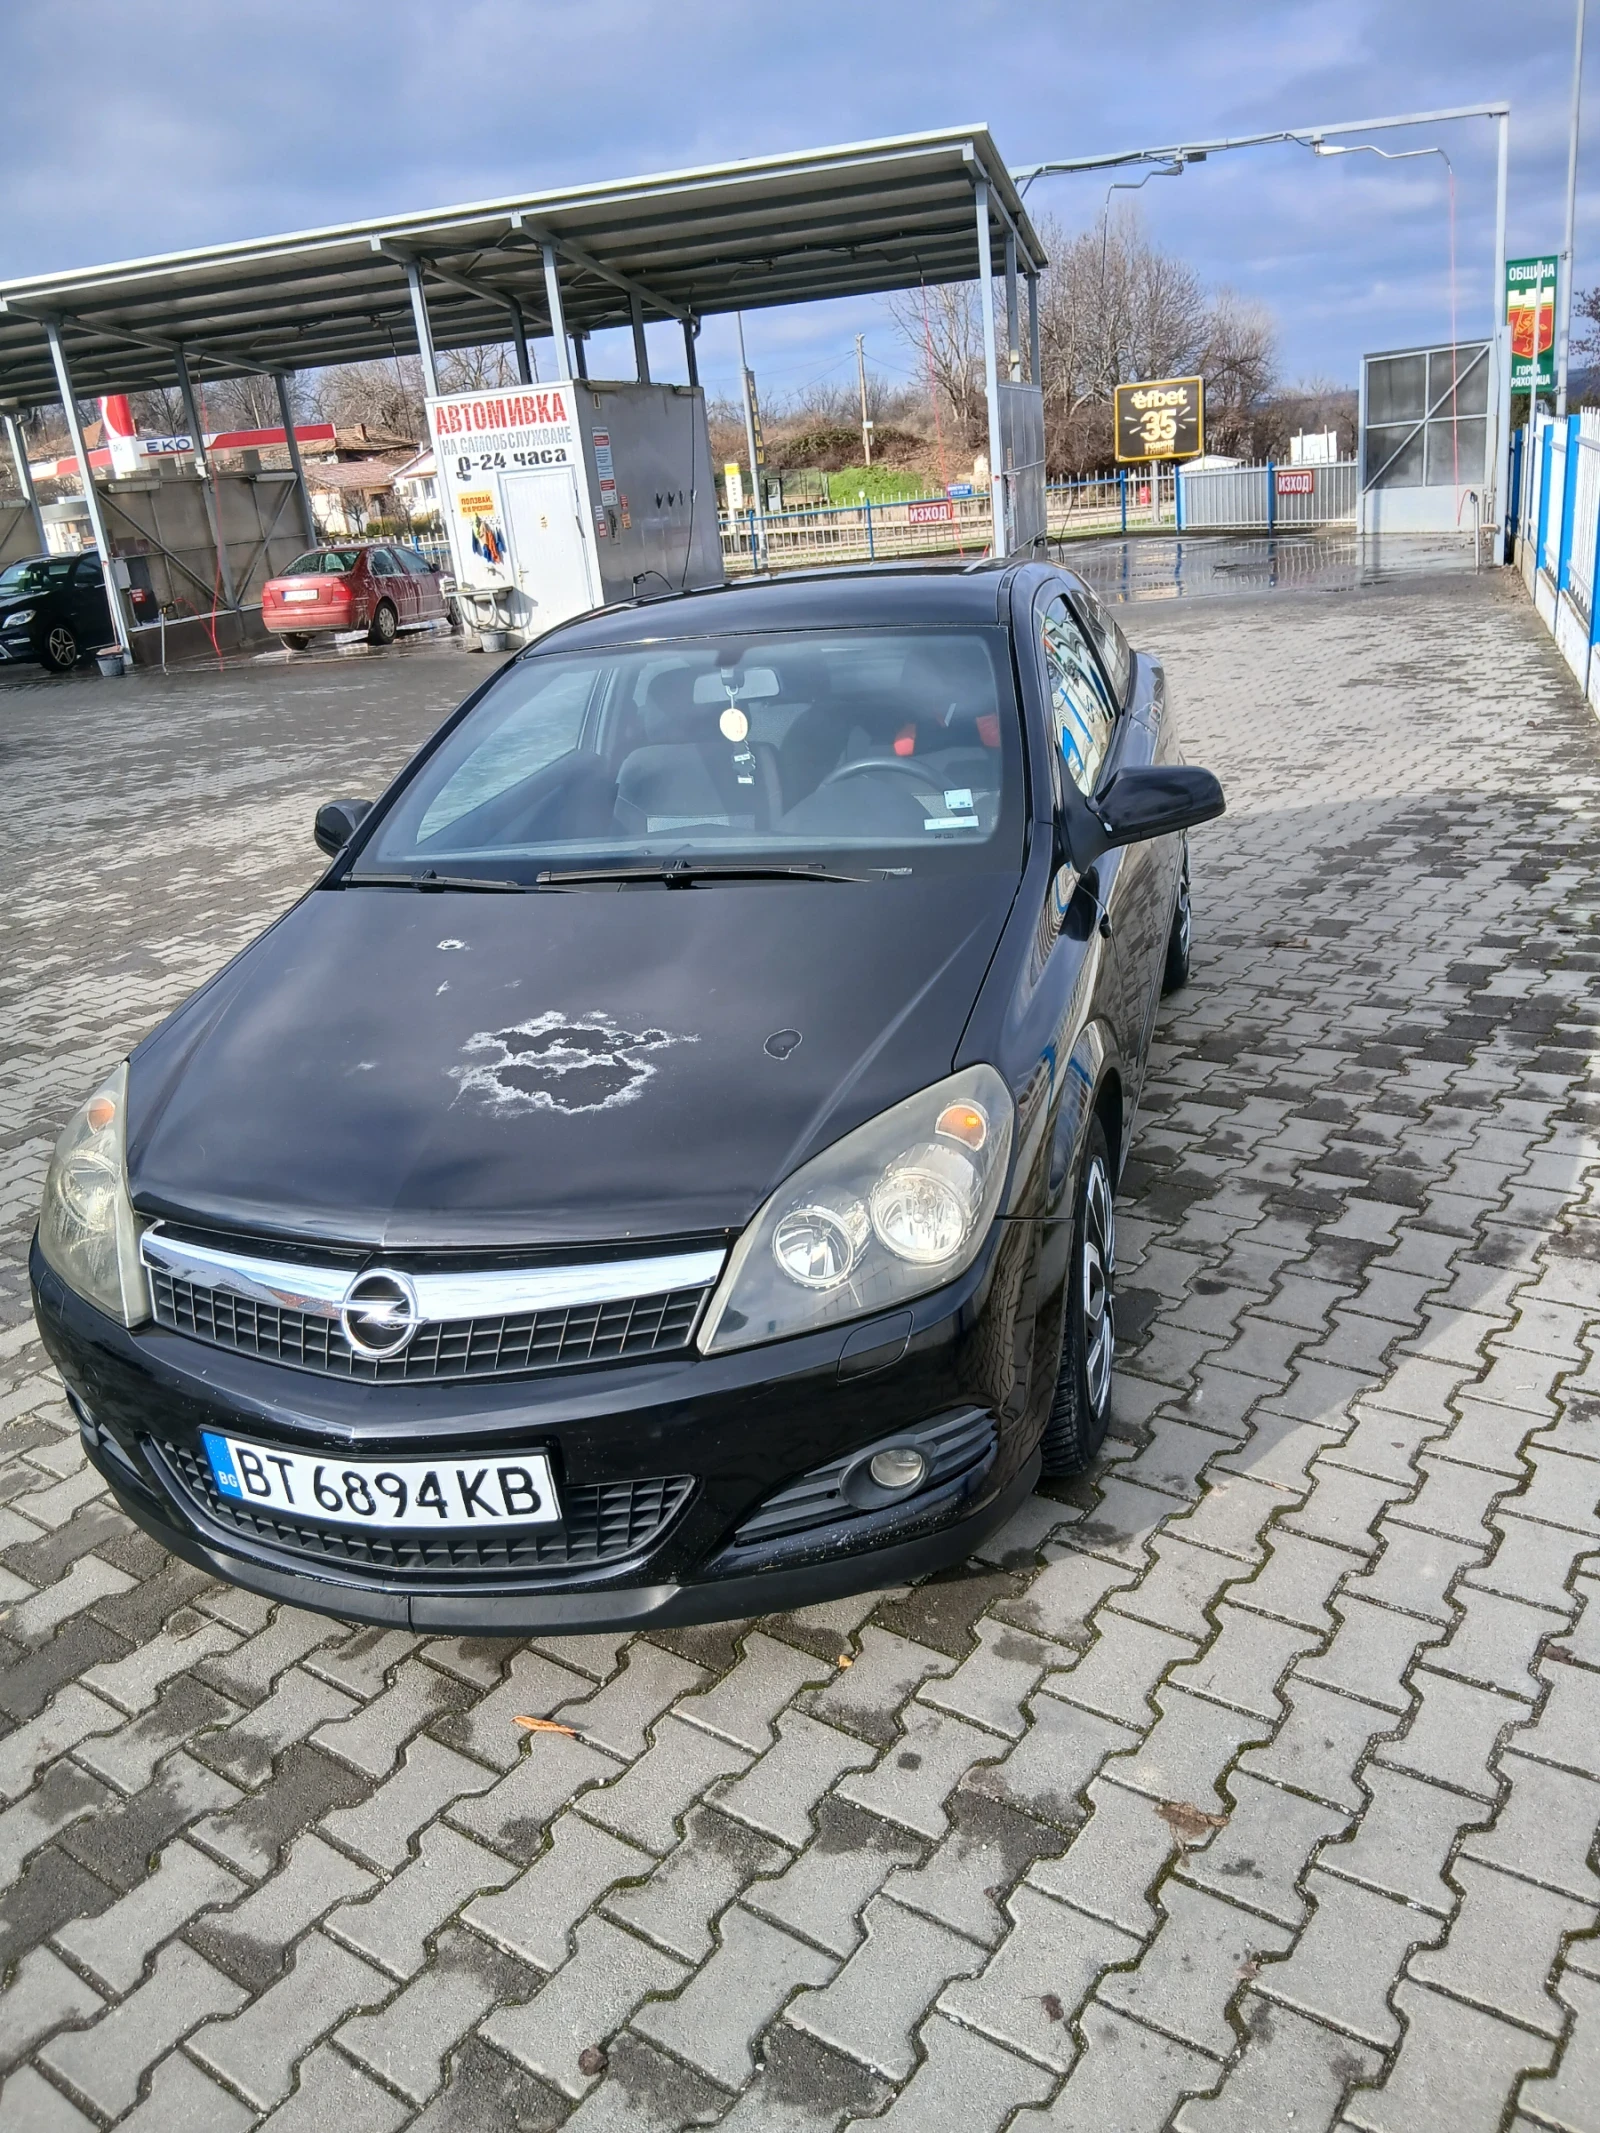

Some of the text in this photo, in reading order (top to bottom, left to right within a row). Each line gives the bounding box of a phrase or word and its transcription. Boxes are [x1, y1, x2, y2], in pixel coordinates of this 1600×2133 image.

[1133, 387, 1187, 409] efbet
[436, 392, 567, 436] АВТОМИВКА
[1140, 408, 1177, 441] 35
[146, 438, 190, 453] EKO
[442, 426, 573, 456] НА САМООБСЛУЖВАНЕ
[457, 448, 567, 472] 0-24 часа
[1278, 475, 1309, 493] ИЗХОД
[910, 505, 948, 522] ИЗХОД
[218, 1447, 543, 1519] BG BT 6894 KB
